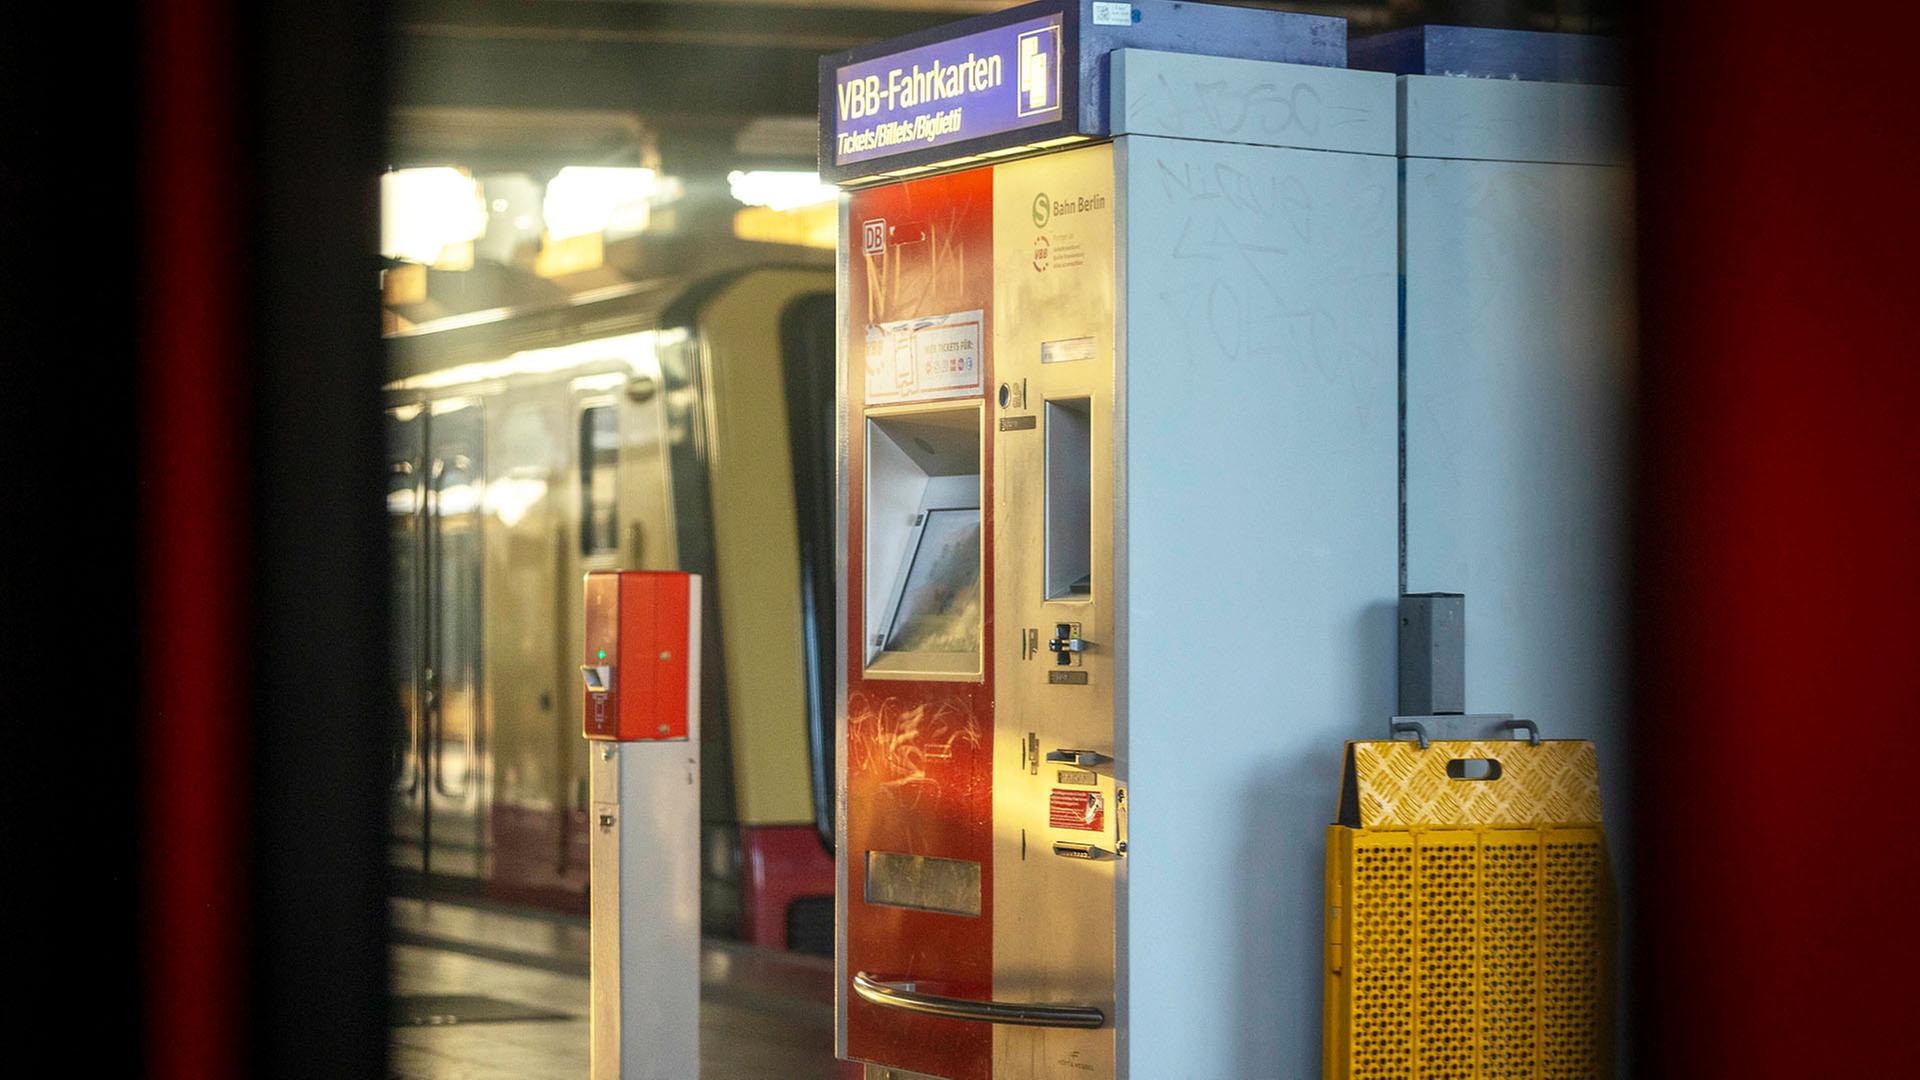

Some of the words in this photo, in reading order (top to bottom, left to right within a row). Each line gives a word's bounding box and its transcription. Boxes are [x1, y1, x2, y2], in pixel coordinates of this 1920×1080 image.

[837, 52, 1002, 121] VBB-Fahrkarten
[837, 107, 962, 155] Tickets/Billets/Biglietti
[1053, 200, 1076, 217] Bahn
[1078, 194, 1105, 213] Berlin
[866, 226, 882, 249] DB
